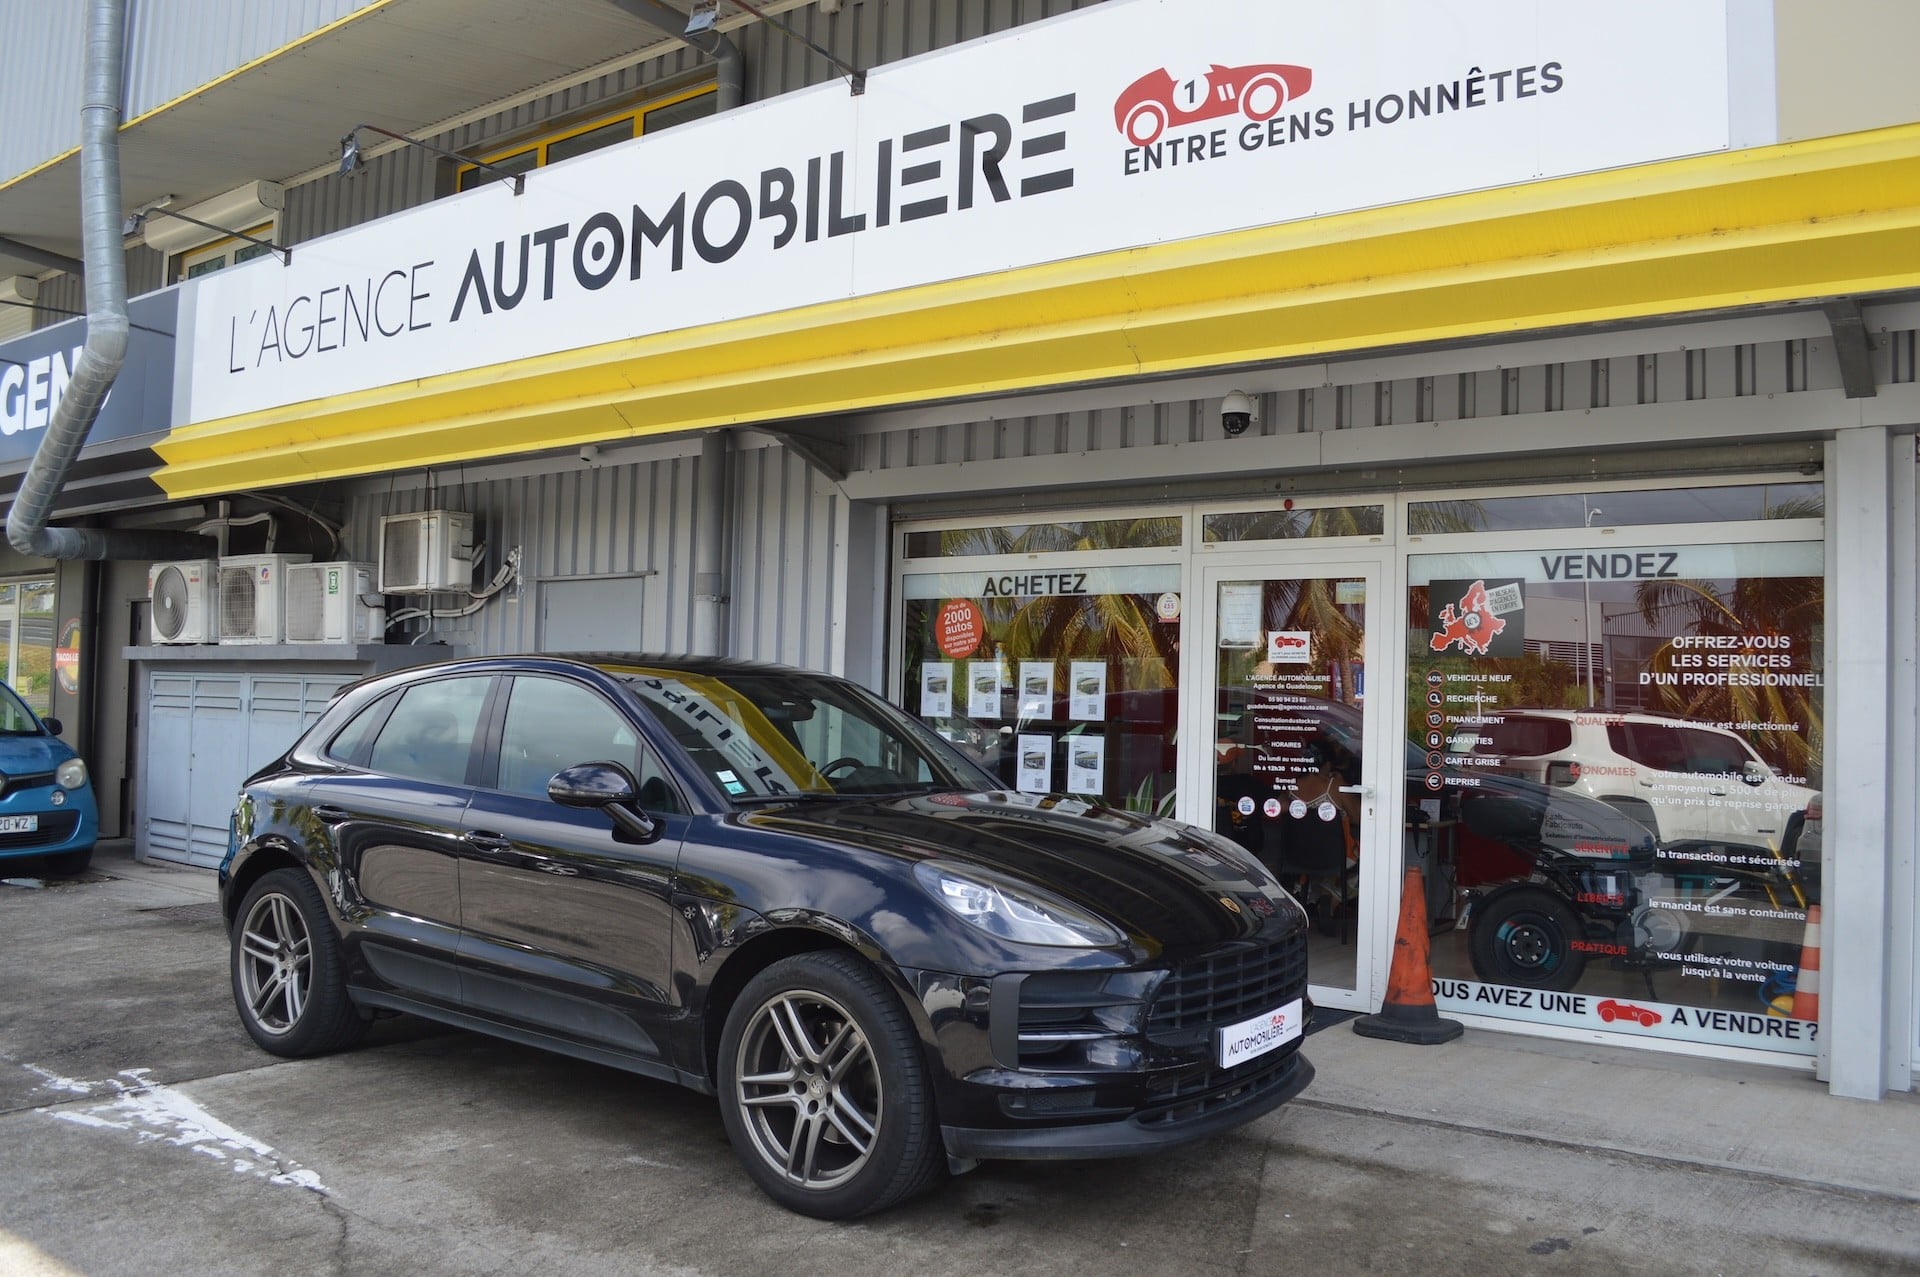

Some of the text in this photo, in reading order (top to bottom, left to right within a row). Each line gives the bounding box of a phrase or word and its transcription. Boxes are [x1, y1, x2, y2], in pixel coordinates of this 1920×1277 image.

[1184, 80, 1196, 104] 1
[1123, 61, 1564, 176] ENTRE GENS HONNÊTES
[229, 93, 1076, 374] L'AGENCE AUTOMOBILIERE
[0, 345, 113, 436] GEN
[1540, 552, 1678, 580] VENDEZ
[983, 573, 1087, 596] ACHETEZ
[944, 608, 972, 625] 2000
[945, 621, 973, 635] autos
[1672, 636, 1791, 649] OFFREZ-VOUS
[1671, 654, 1792, 668] LES SERVICES
[1640, 672, 1825, 687] D'UN PROFESSIONNEL
[1286, 683, 1323, 691] Guadeloupe
[1446, 695, 1498, 703] RECHERCHE
[1446, 716, 1505, 724] FINANCEMENT
[1576, 714, 1625, 727] QUALITÉ
[1717, 722, 1733, 730] est
[1735, 720, 1800, 731] sélectionné
[1446, 736, 1493, 745] GARANTIES
[1445, 757, 1501, 766] CARTE GRISE
[1445, 777, 1481, 786] REPRISE
[1681, 771, 1743, 782] automobile
[1746, 774, 1762, 782] est
[1764, 773, 1808, 784] vendue
[1667, 785, 1717, 795] moyenne
[1651, 796, 1681, 807] qu'un
[1684, 797, 1705, 808] prix
[1707, 798, 1721, 807] de
[1724, 799, 1762, 810] reprise
[1656, 848, 1800, 867] la transaction est sécurisée
[1649, 898, 1806, 921] le mandat est sans contrainte
[1571, 941, 1628, 956] PRATIQUE
[1656, 951, 1794, 972] vous utilisez votre voiture
[1681, 965, 1766, 983] jusqu'à la vente
[1431, 980, 1470, 1000] OUS
[1475, 986, 1533, 1009] AVEZ
[1540, 994, 1587, 1015] UNE
[1671, 1007, 1688, 1026] A
[1695, 1010, 1800, 1040] VENDRE
